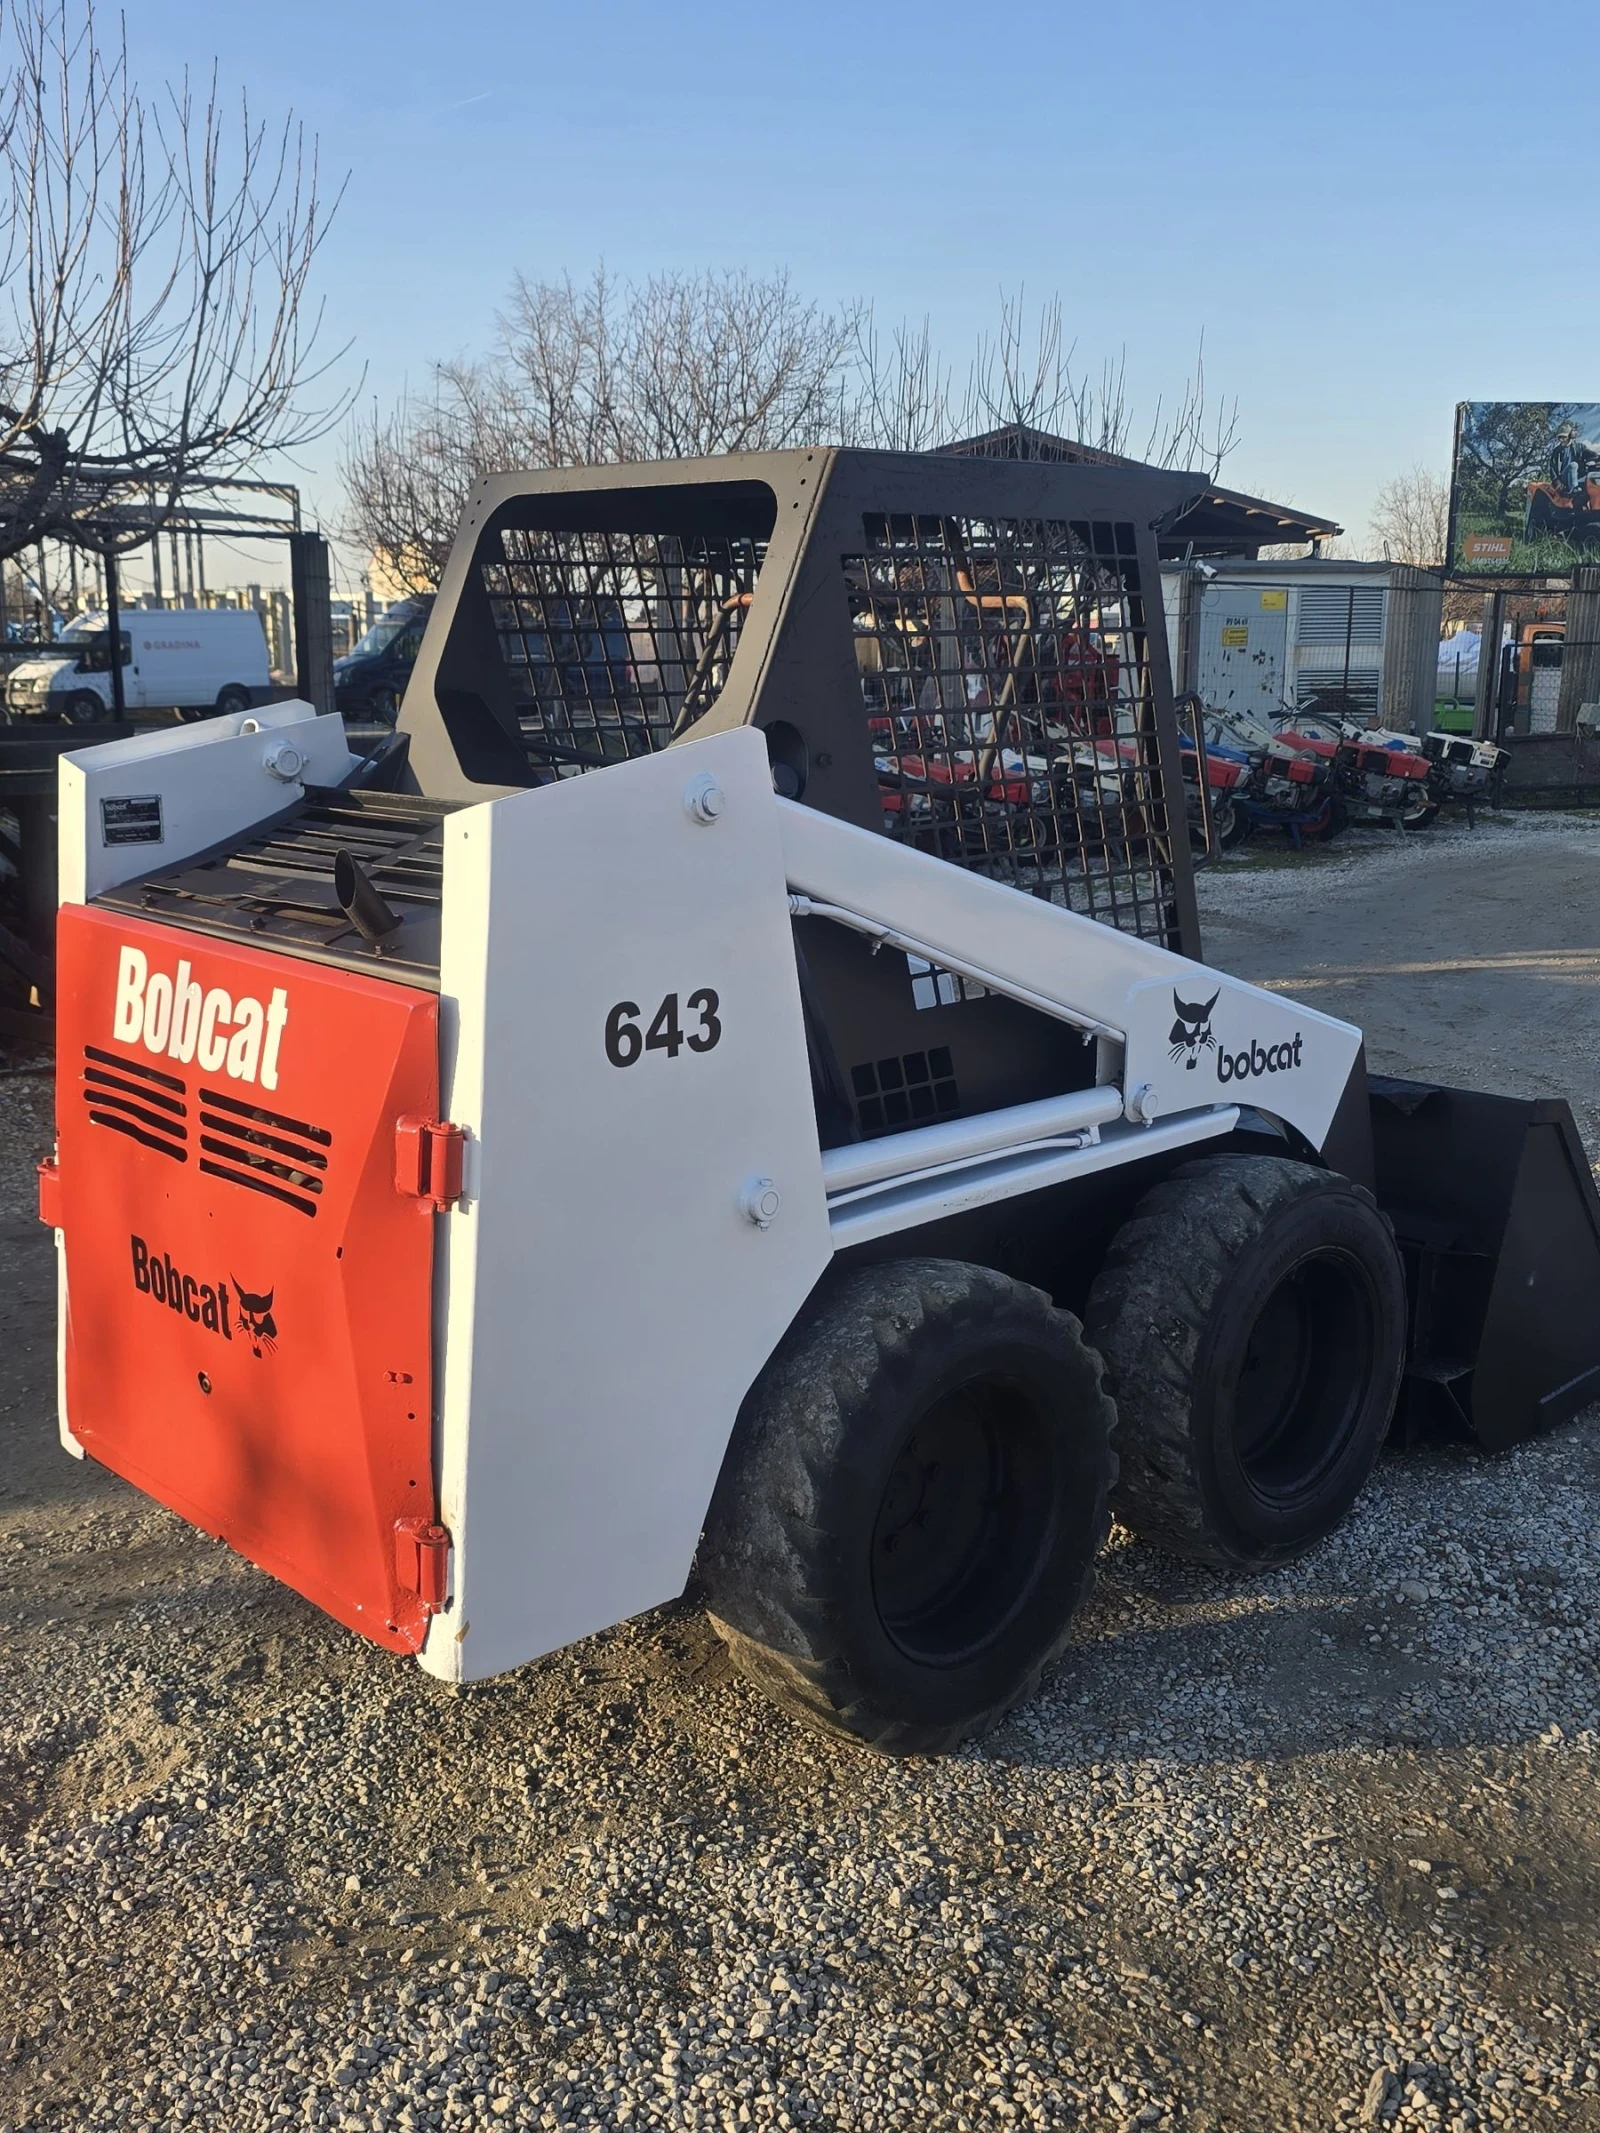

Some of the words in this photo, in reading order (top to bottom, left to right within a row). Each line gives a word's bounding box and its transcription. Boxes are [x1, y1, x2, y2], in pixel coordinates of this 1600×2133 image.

[1473, 543, 1506, 552] STIHL
[113, 945, 289, 1091] Bobcat
[604, 988, 722, 1068] 643
[1217, 1032, 1302, 1083] bobcat
[131, 1234, 232, 1340] Bobcat
